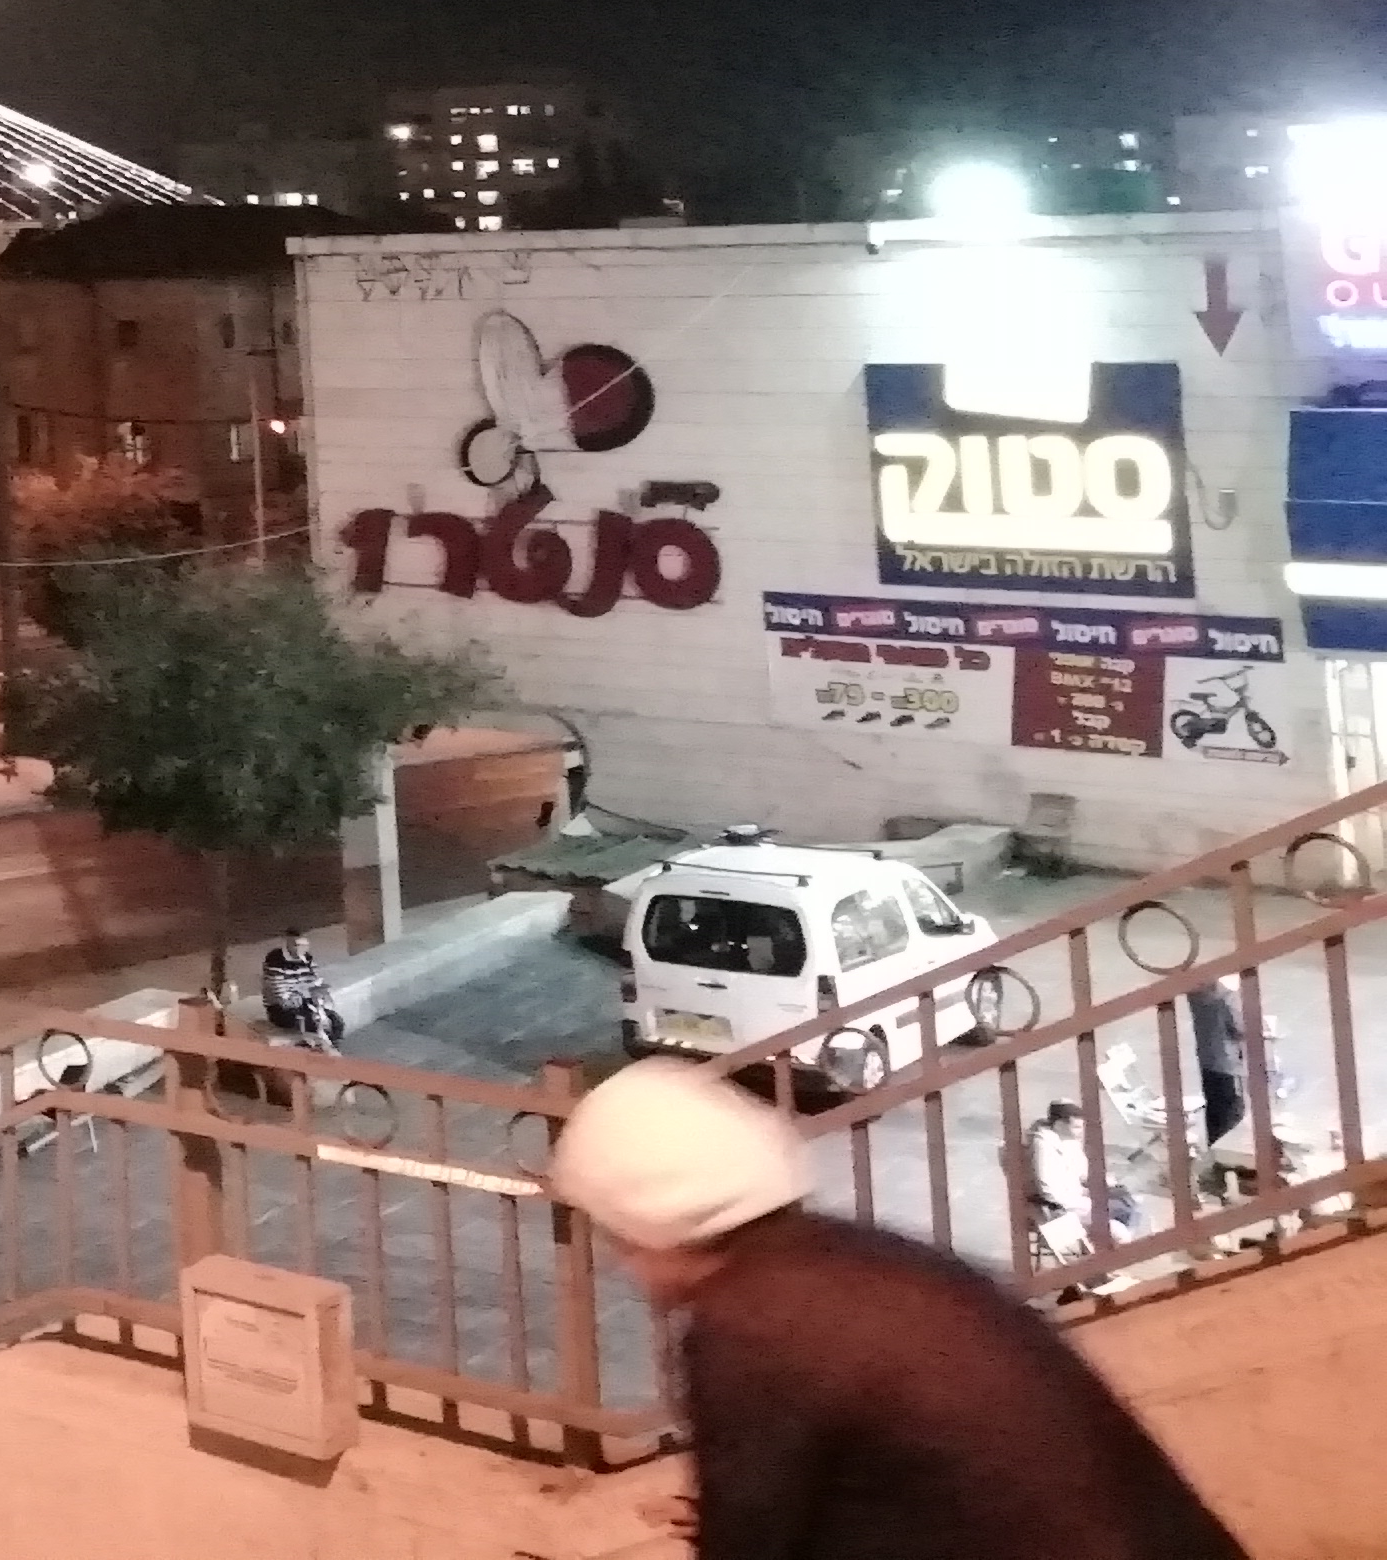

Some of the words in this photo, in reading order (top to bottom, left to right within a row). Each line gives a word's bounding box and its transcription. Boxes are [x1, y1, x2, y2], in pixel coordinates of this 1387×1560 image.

[875, 433, 1172, 552] סטוק
[895, 544, 998, 574] בישראל
[1004, 550, 1082, 579] הזולה
[1091, 557, 1177, 583] הרשת
